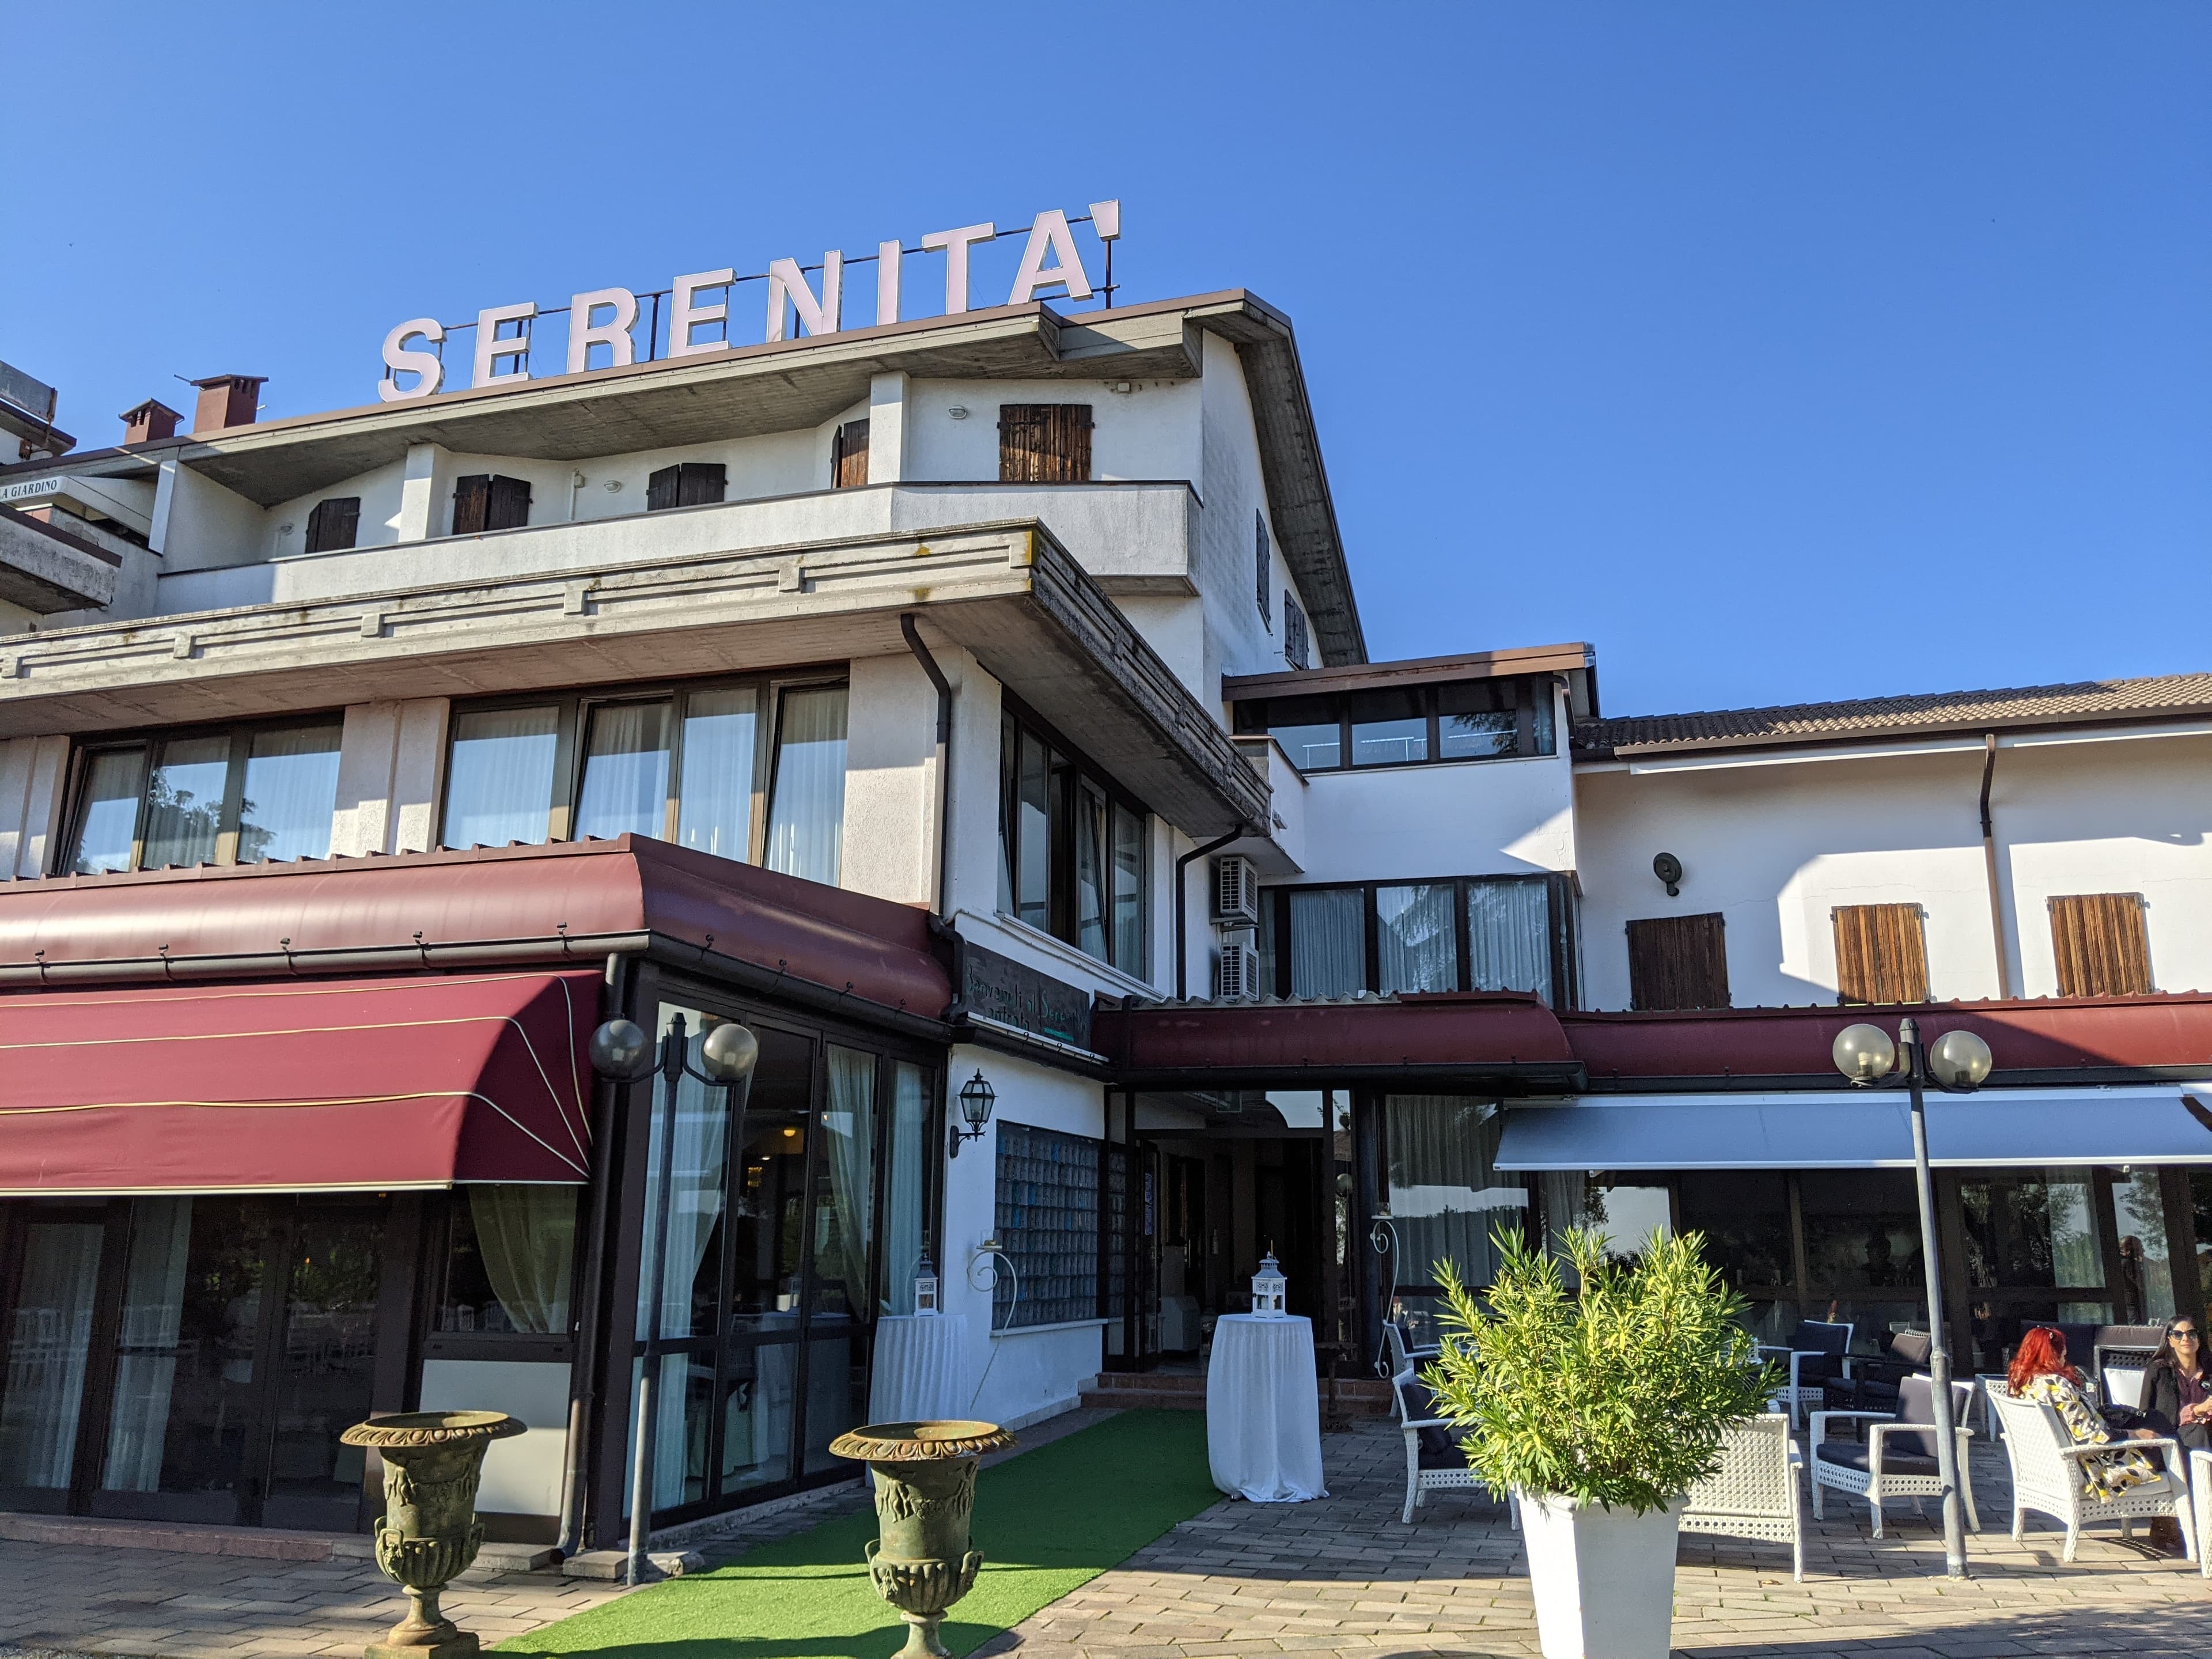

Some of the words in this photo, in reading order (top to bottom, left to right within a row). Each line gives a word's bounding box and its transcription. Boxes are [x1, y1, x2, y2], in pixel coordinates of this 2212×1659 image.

[378, 199, 1120, 403] SERENITA'
[0, 488, 7, 499] A
[11, 479, 57, 497] GIARDINO
